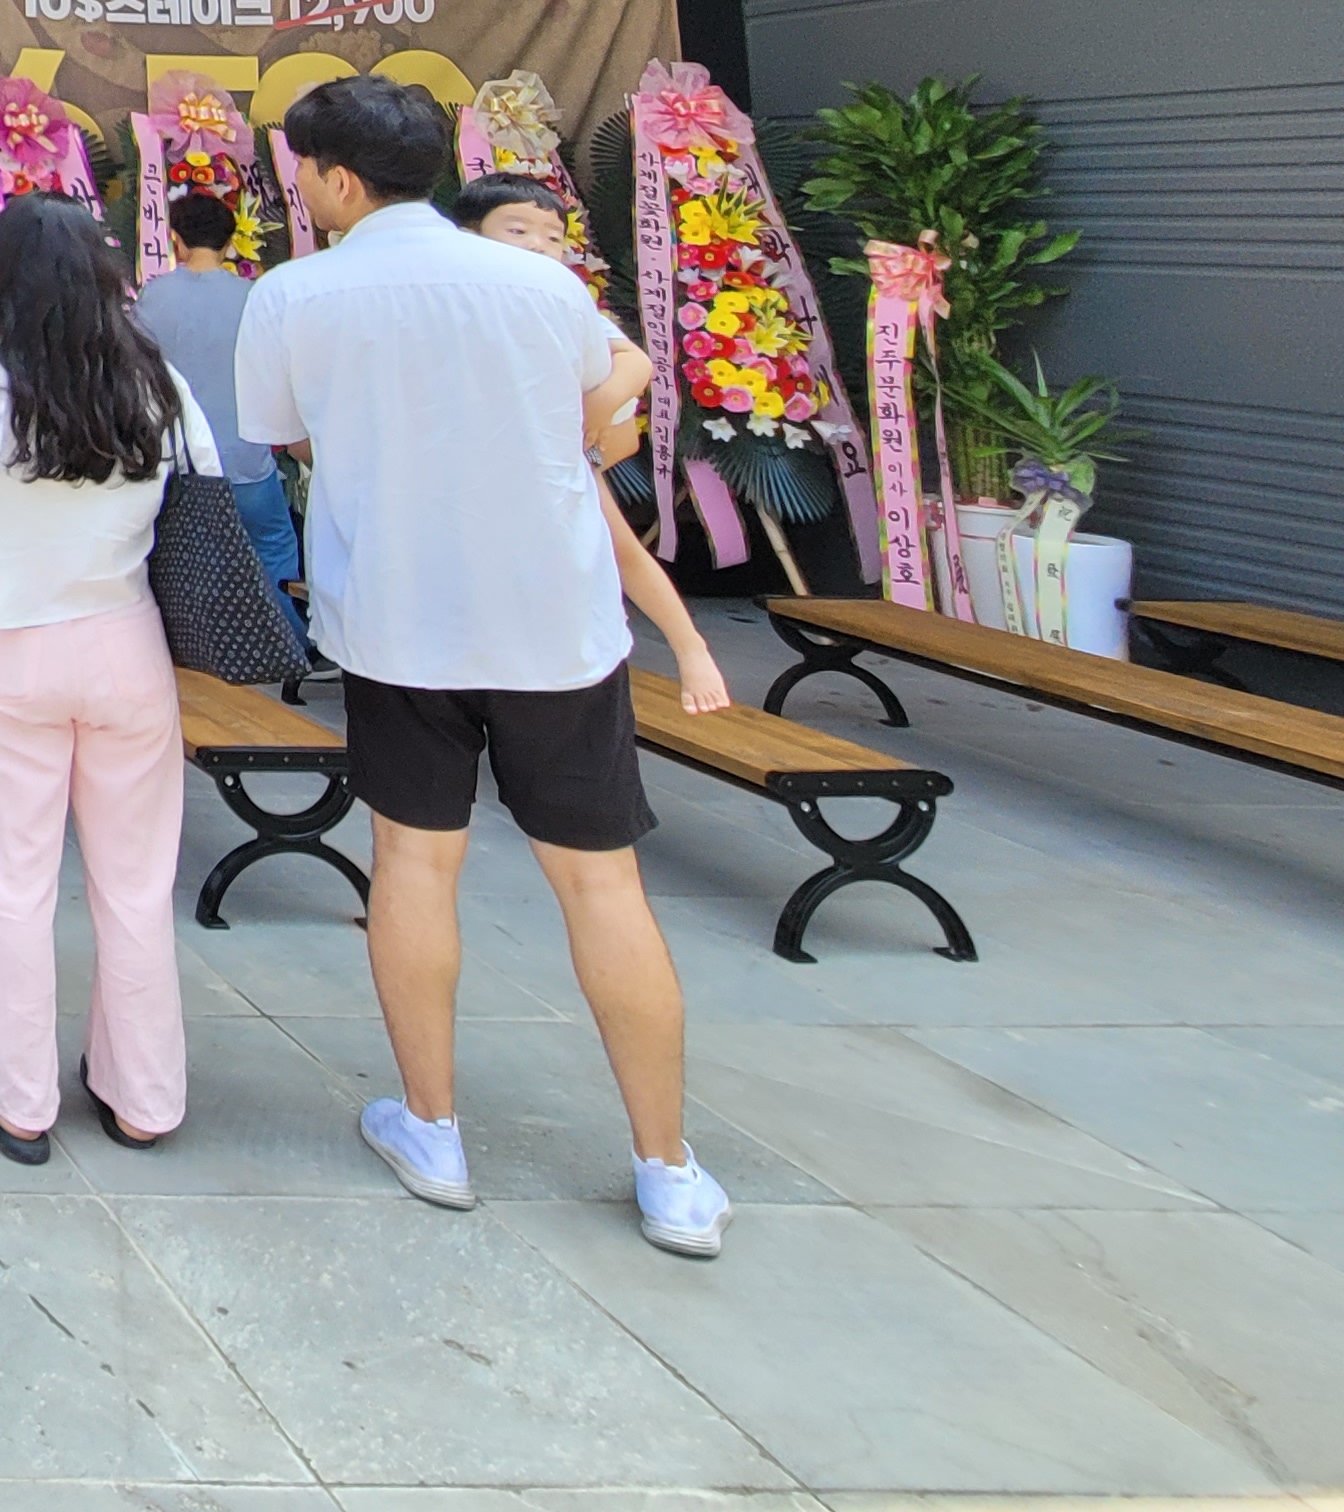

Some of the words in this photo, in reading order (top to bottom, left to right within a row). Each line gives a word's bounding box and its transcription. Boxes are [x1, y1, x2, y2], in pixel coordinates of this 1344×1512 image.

[875, 322, 906, 454] 진주문화원
[887, 462, 908, 498] 이사
[887, 509, 921, 587] 이상호
